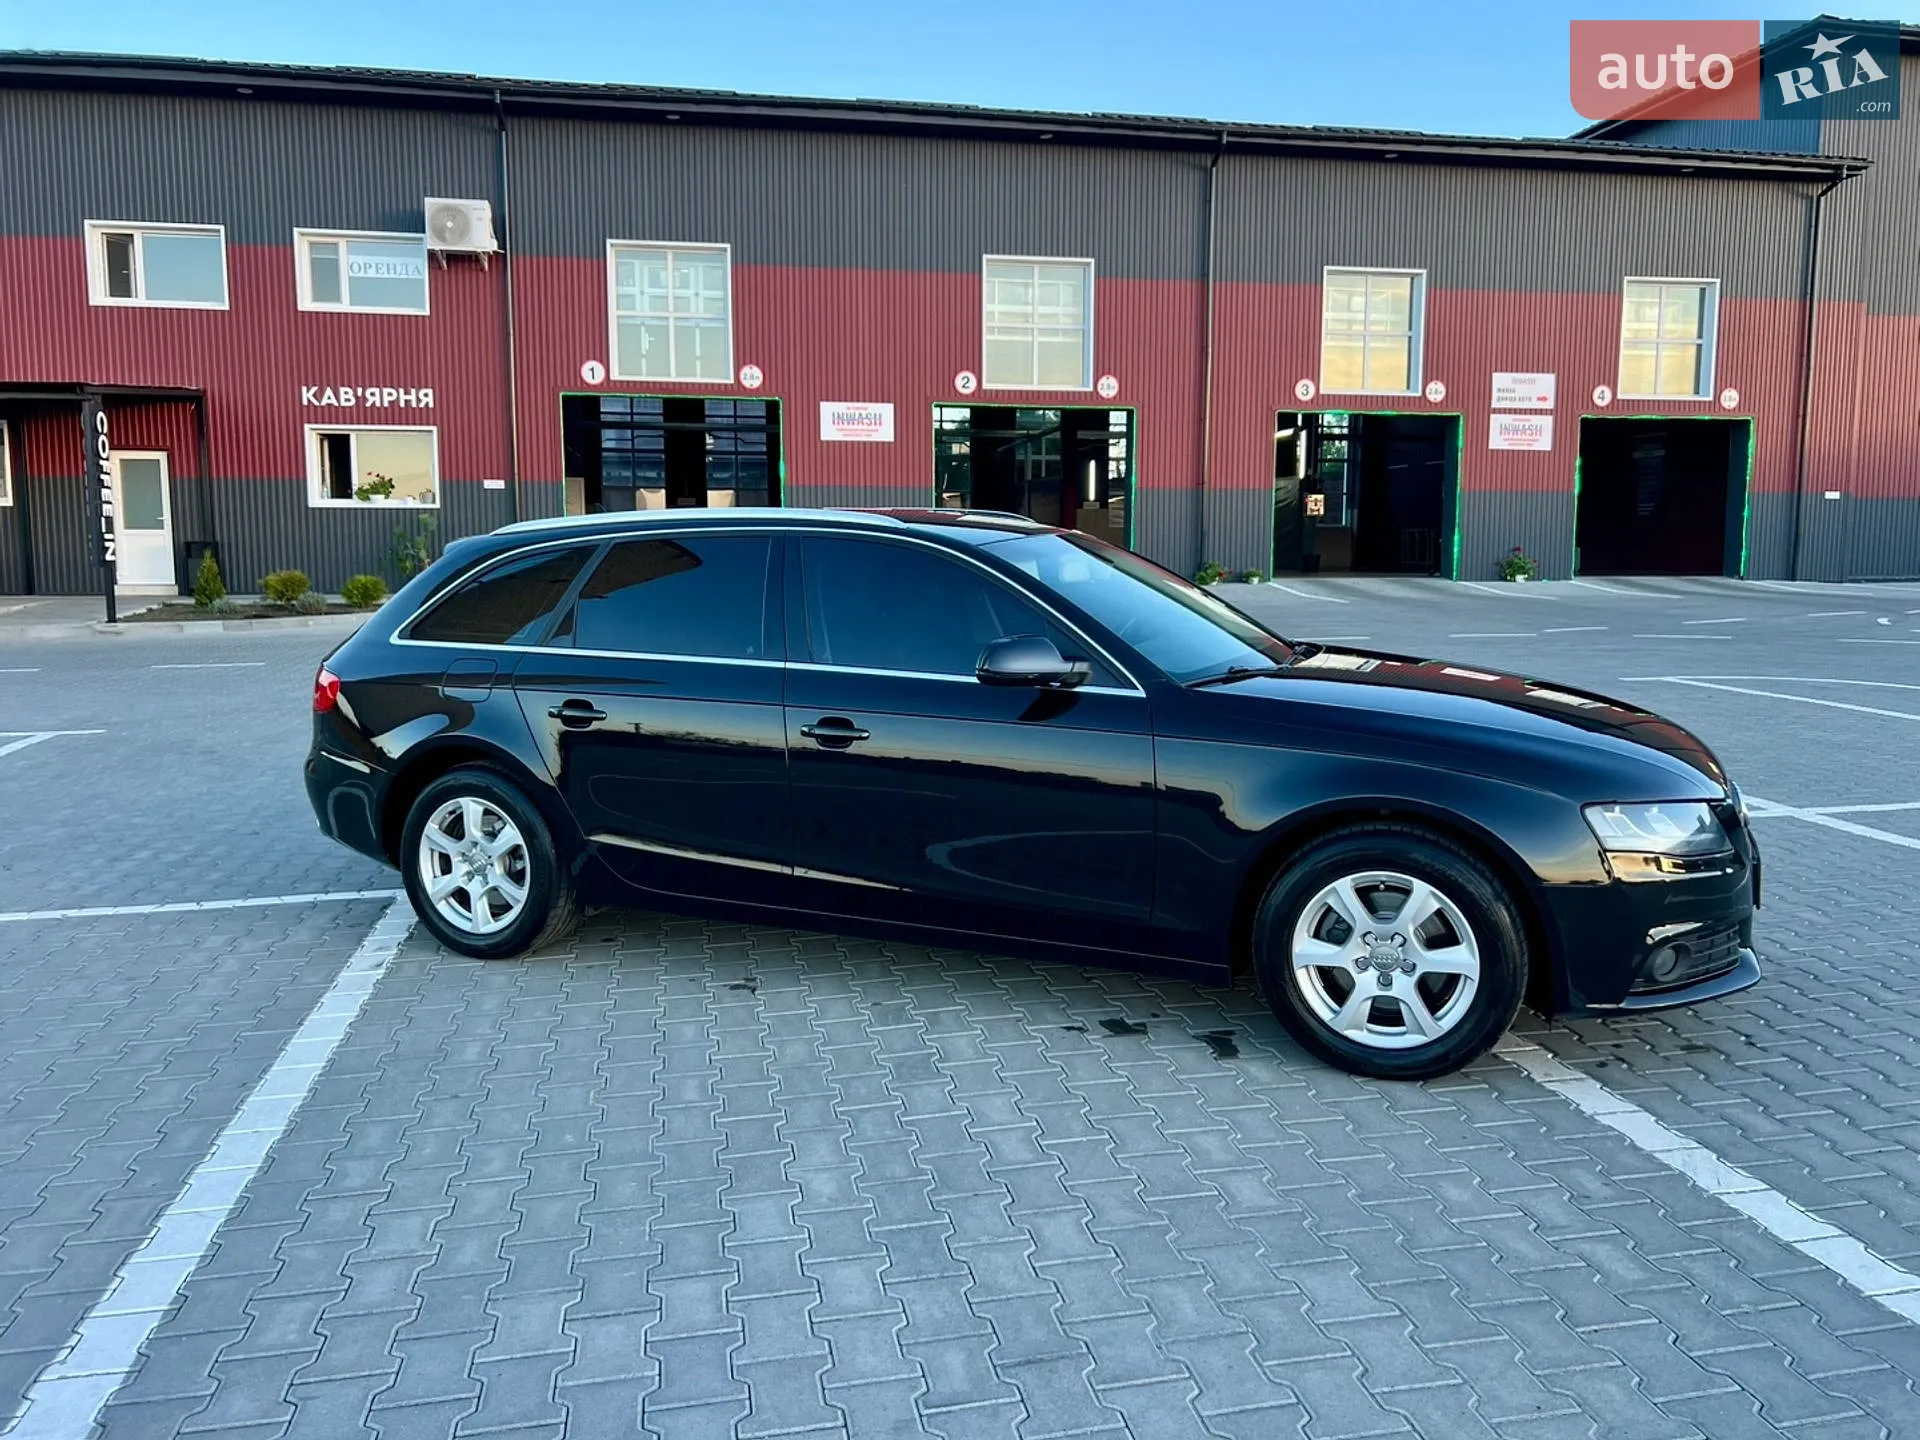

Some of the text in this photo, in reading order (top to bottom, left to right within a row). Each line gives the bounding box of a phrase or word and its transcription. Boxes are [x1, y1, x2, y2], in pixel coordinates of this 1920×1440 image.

[349, 261, 422, 276] ОРЕНДА
[588, 366, 595, 380] 1
[961, 375, 971, 389] 2
[301, 385, 435, 408] КАВ'ЯРНЯ
[1301, 383, 1310, 397] 3
[1597, 389, 1606, 402] 4
[831, 411, 882, 427] INWASH
[1499, 423, 1543, 438] INWASH
